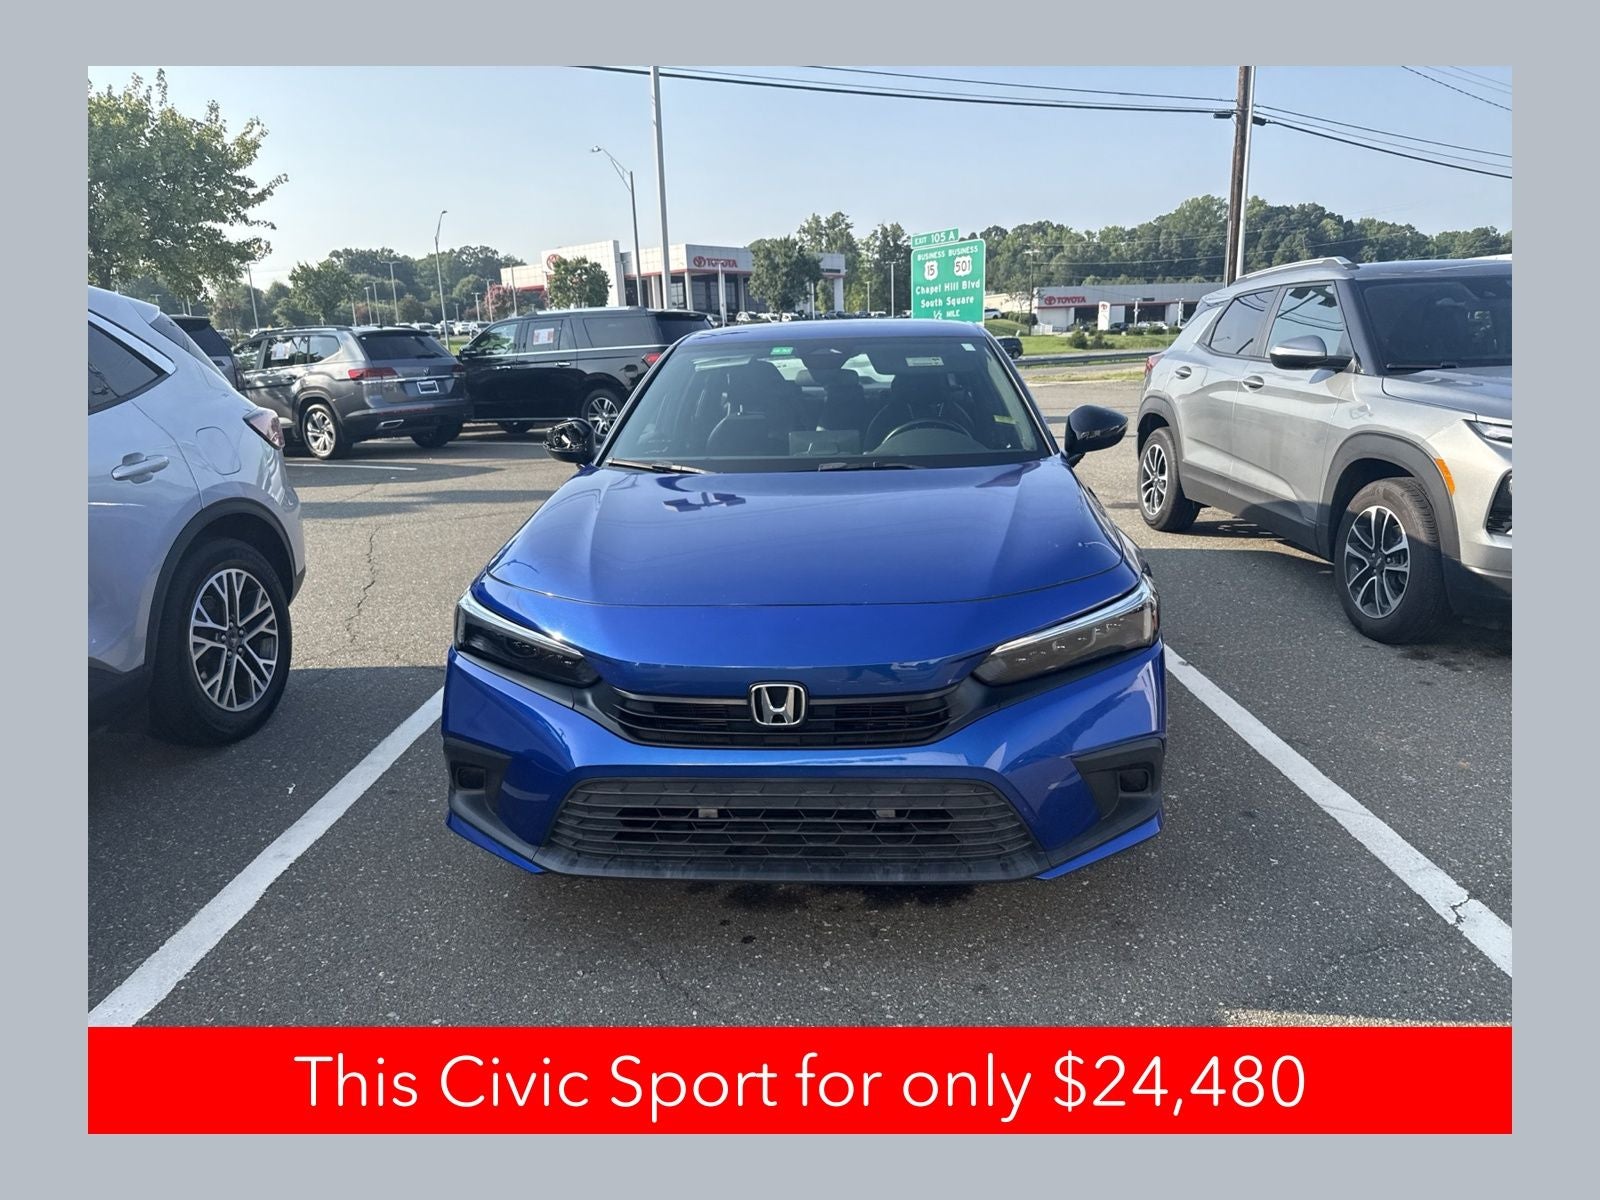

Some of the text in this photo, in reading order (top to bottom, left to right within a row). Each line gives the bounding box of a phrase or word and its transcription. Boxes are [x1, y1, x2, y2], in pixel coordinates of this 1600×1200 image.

[931, 232, 946, 243] 105
[949, 231, 956, 241] A
[917, 245, 979, 261] BUSINESS BUSINESS
[927, 264, 936, 277] 15
[955, 259, 971, 273] 501
[915, 278, 981, 295] Chapel Hill Blvd
[920, 295, 974, 309] South Square
[1056, 296, 1087, 305] TOYOTA
